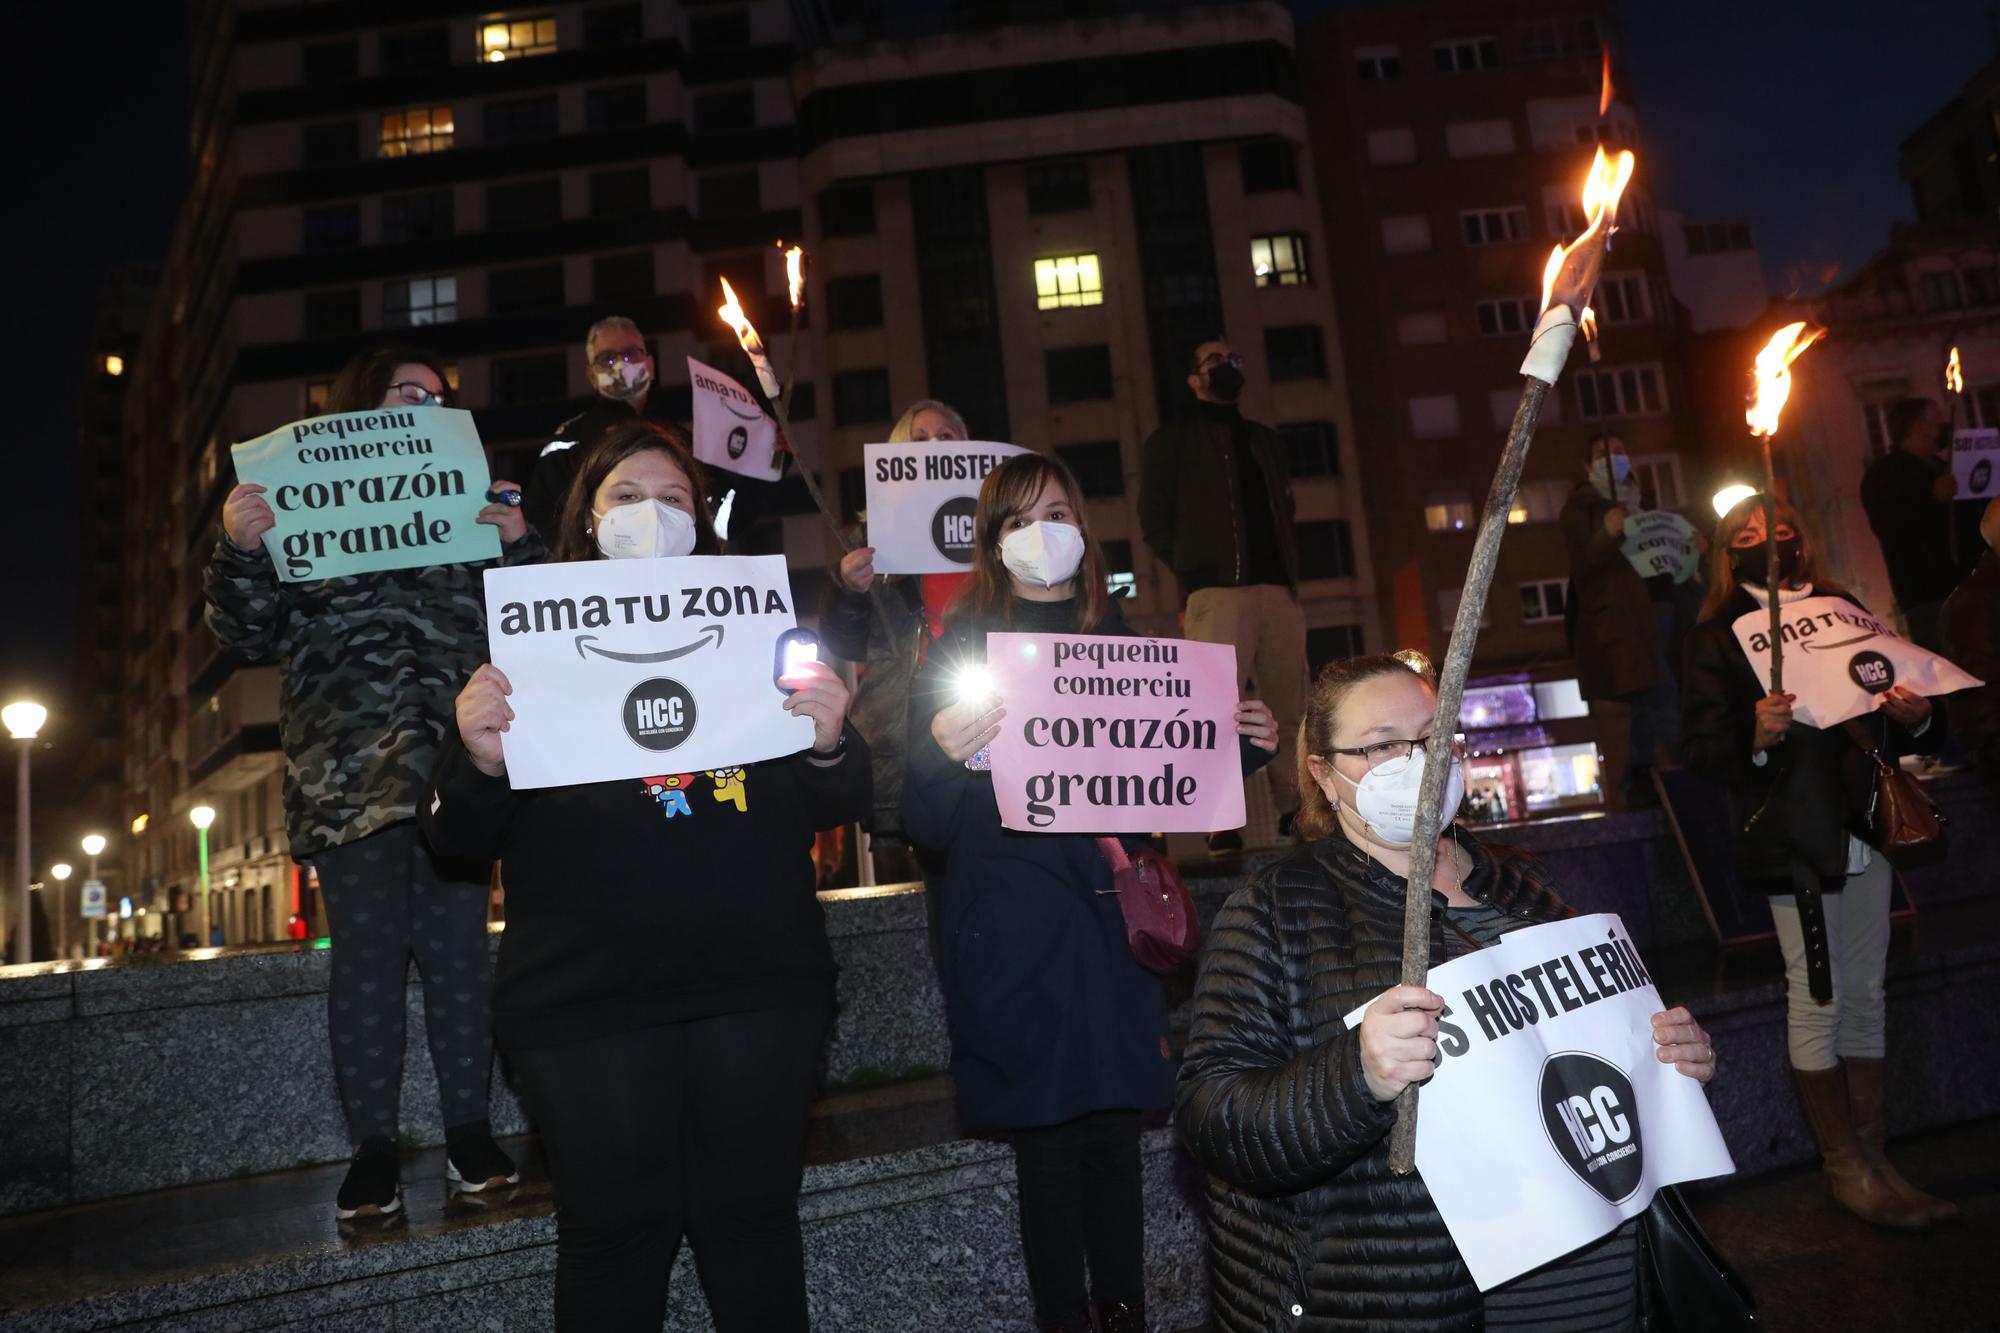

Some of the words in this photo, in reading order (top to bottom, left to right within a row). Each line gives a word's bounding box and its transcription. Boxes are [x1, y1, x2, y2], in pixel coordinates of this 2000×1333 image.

[292, 411, 416, 443] pequeñu
[298, 434, 433, 464] comerciu
[875, 456, 918, 482] SOS
[925, 454, 1012, 481] HOSTE
[275, 463, 465, 511] corazón
[283, 511, 451, 577] grande
[943, 515, 976, 544] HC
[1053, 639, 1179, 669] pequeñu
[1053, 671, 1191, 698] comerciu
[1855, 660, 1887, 683] HCC
[636, 696, 684, 729] HCC
[1023, 708, 1217, 750] corazón
[1025, 763, 1197, 828] grande
[1462, 927, 1653, 1042] HOSTELERÍA
[1556, 1085, 1631, 1160] HCC
